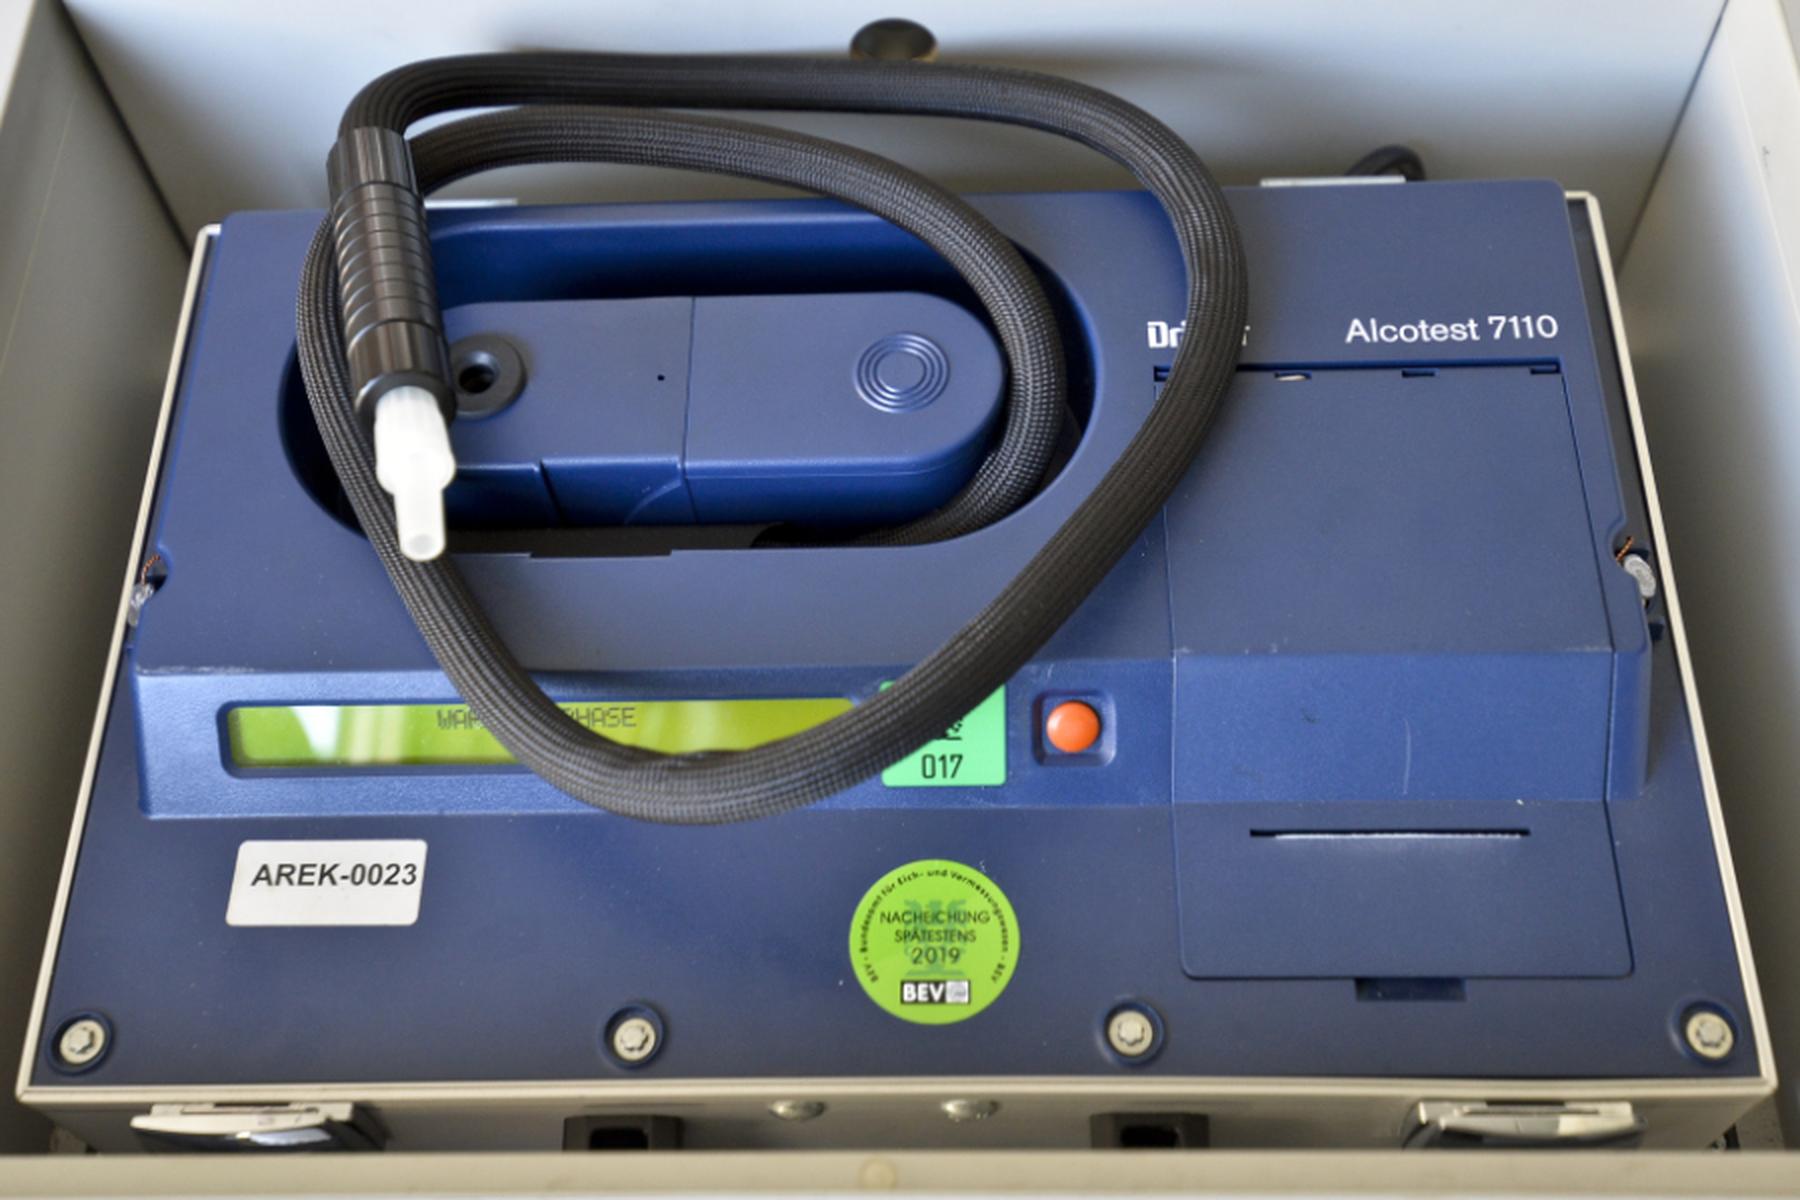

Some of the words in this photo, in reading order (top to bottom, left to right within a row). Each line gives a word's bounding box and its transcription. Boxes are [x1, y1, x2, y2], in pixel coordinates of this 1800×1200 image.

[1345, 317, 1481, 344] Alcotest
[1487, 313, 1559, 341] 7110
[921, 753, 964, 779] 017
[251, 863, 418, 887] AREK-0023
[879, 909, 992, 926] NACHEICHUNG
[911, 946, 961, 966] 2019
[902, 982, 946, 1003] BEV
